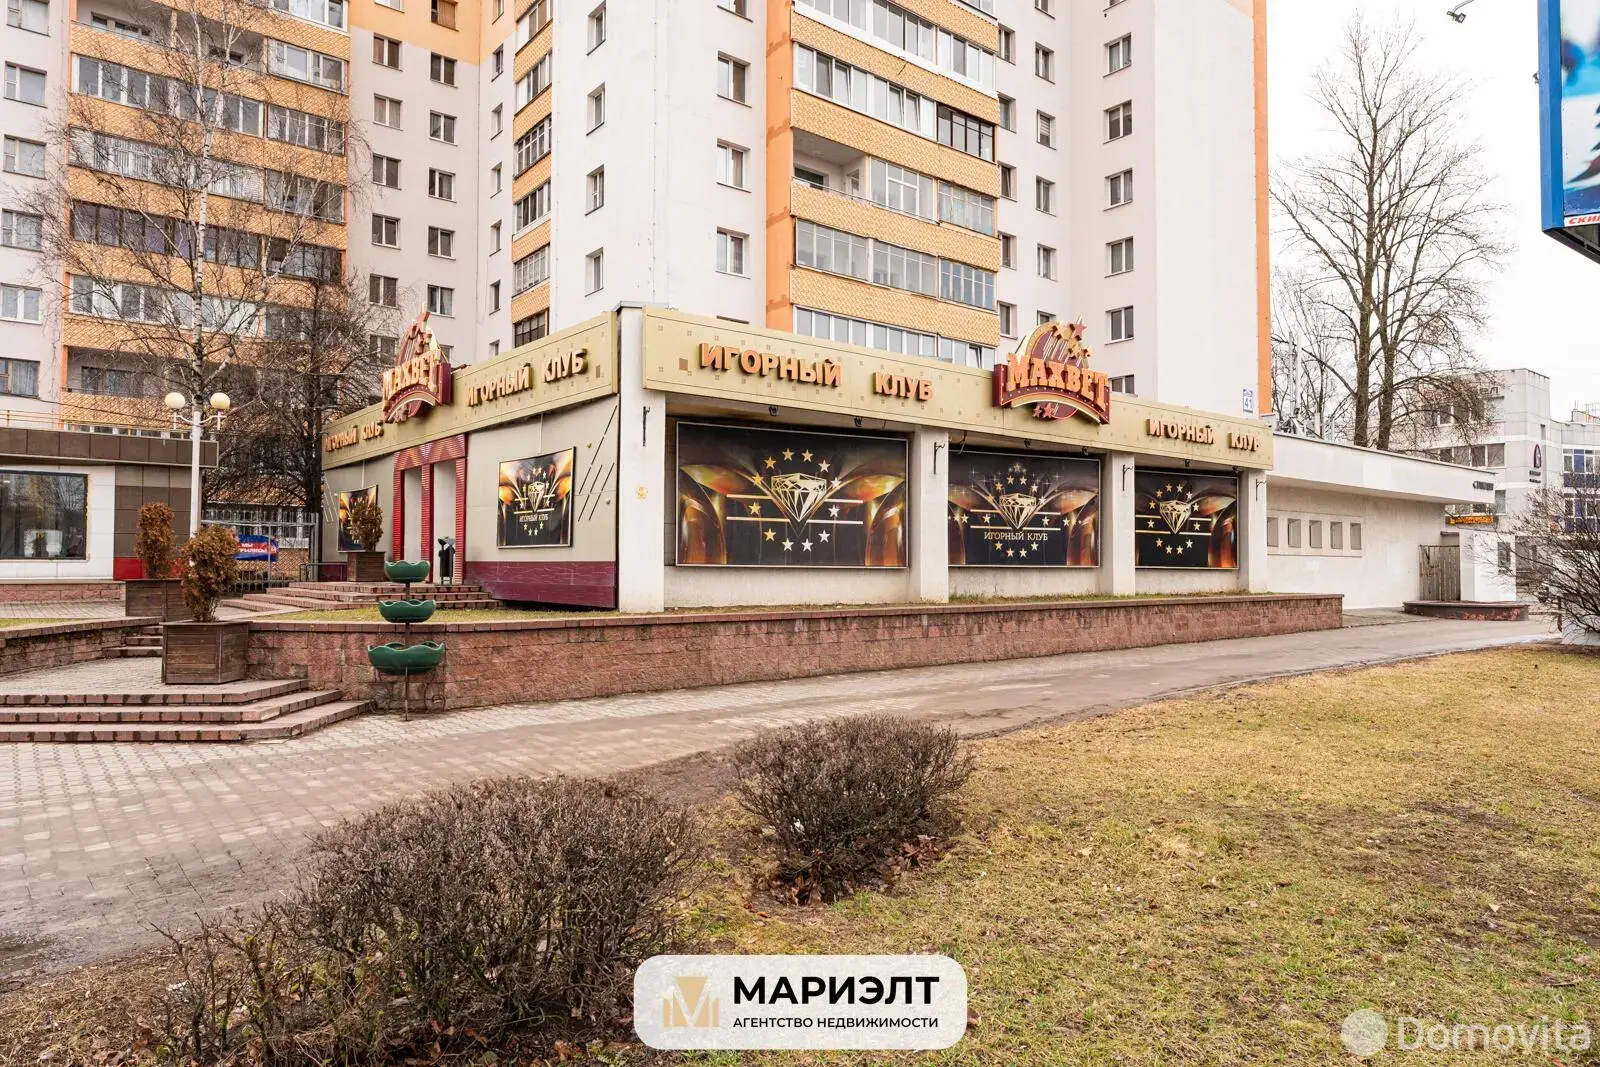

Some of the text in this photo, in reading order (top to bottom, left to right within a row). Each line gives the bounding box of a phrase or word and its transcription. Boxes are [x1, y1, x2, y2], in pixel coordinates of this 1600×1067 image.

[382, 350, 440, 408] MAXBET
[465, 348, 587, 406] ИГОРНЫЙ КЛУБ
[700, 342, 935, 402] ИГОРНЫЙ КЛУБ
[1006, 352, 1109, 410] MAXBET
[1244, 397, 1253, 409] 41
[324, 420, 384, 452] ИГОРНЫЙ КЛУБ
[1147, 418, 1260, 452] ИГОРНЫЙ КЛУБ
[984, 531, 1049, 541] ИГОРНЫЙ КЛУБ
